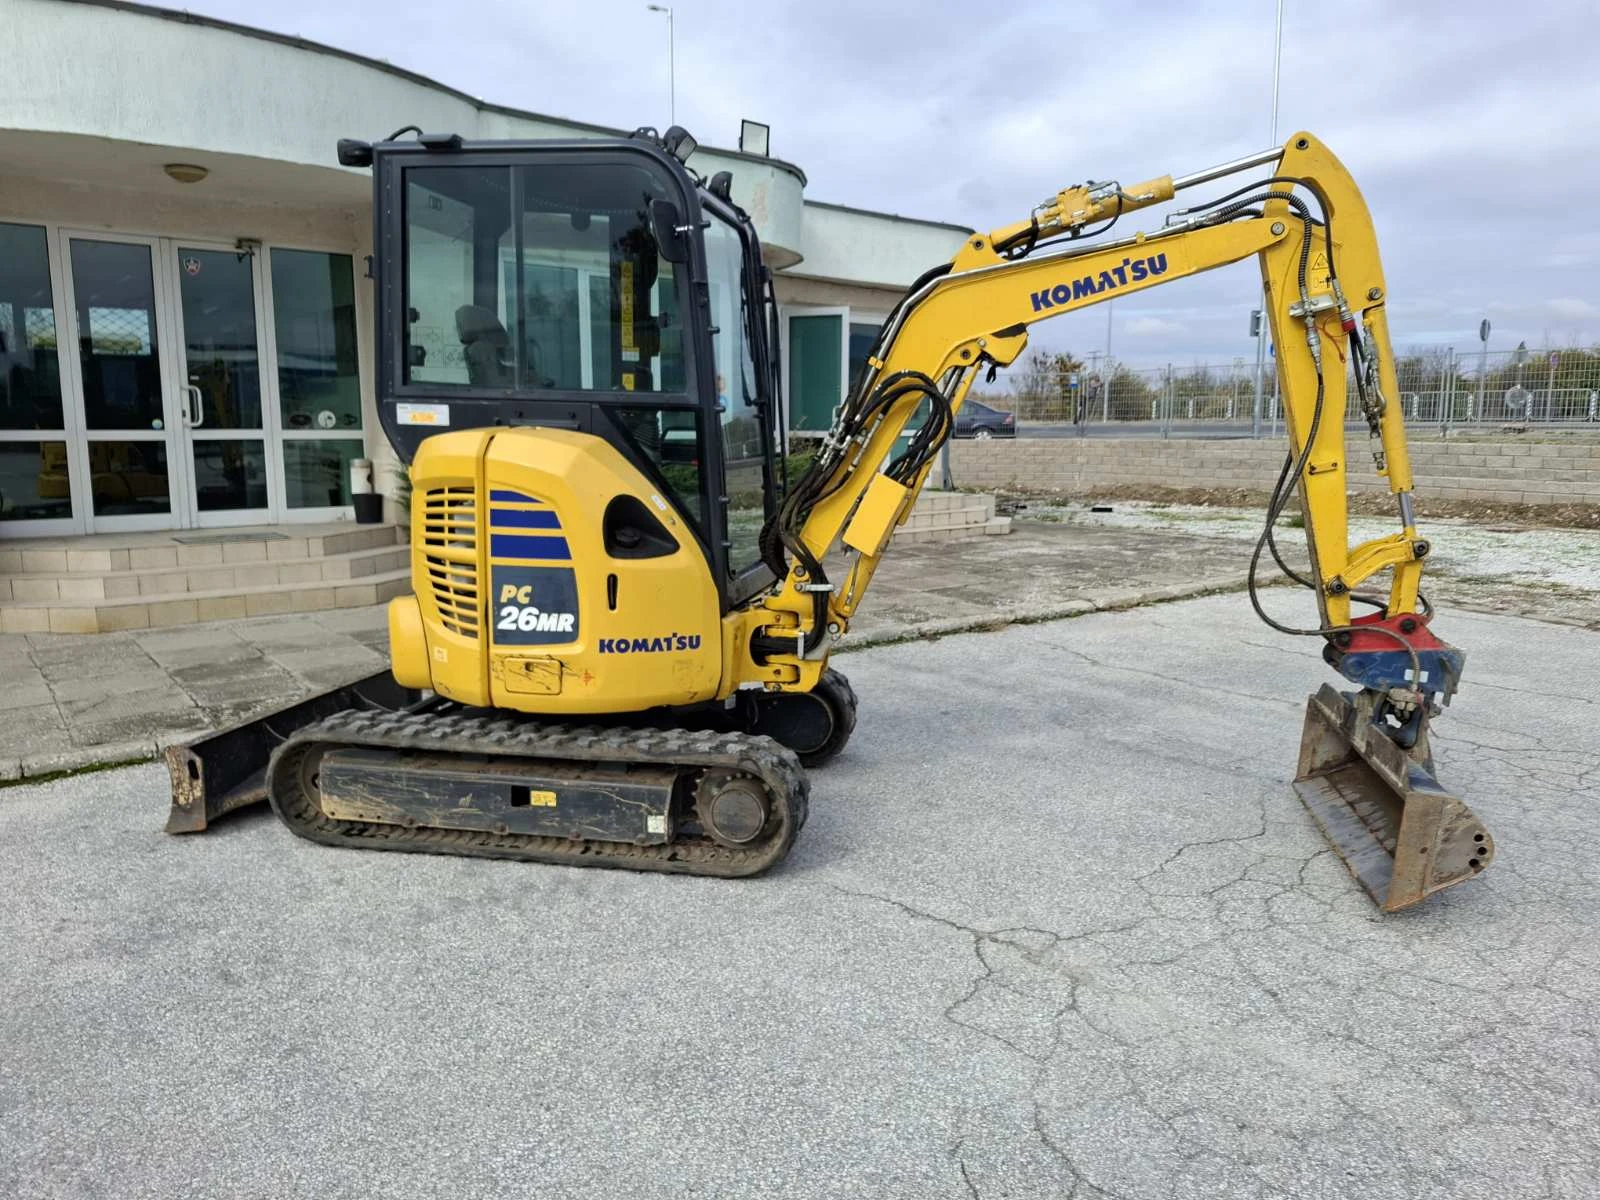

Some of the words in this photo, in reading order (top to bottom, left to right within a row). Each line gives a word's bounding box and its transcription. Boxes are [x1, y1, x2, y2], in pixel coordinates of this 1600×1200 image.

[1030, 253, 1168, 313] KOMATSU
[500, 584, 532, 604] PC
[497, 605, 575, 632] 26MR
[599, 632, 701, 654] KOMATSU
